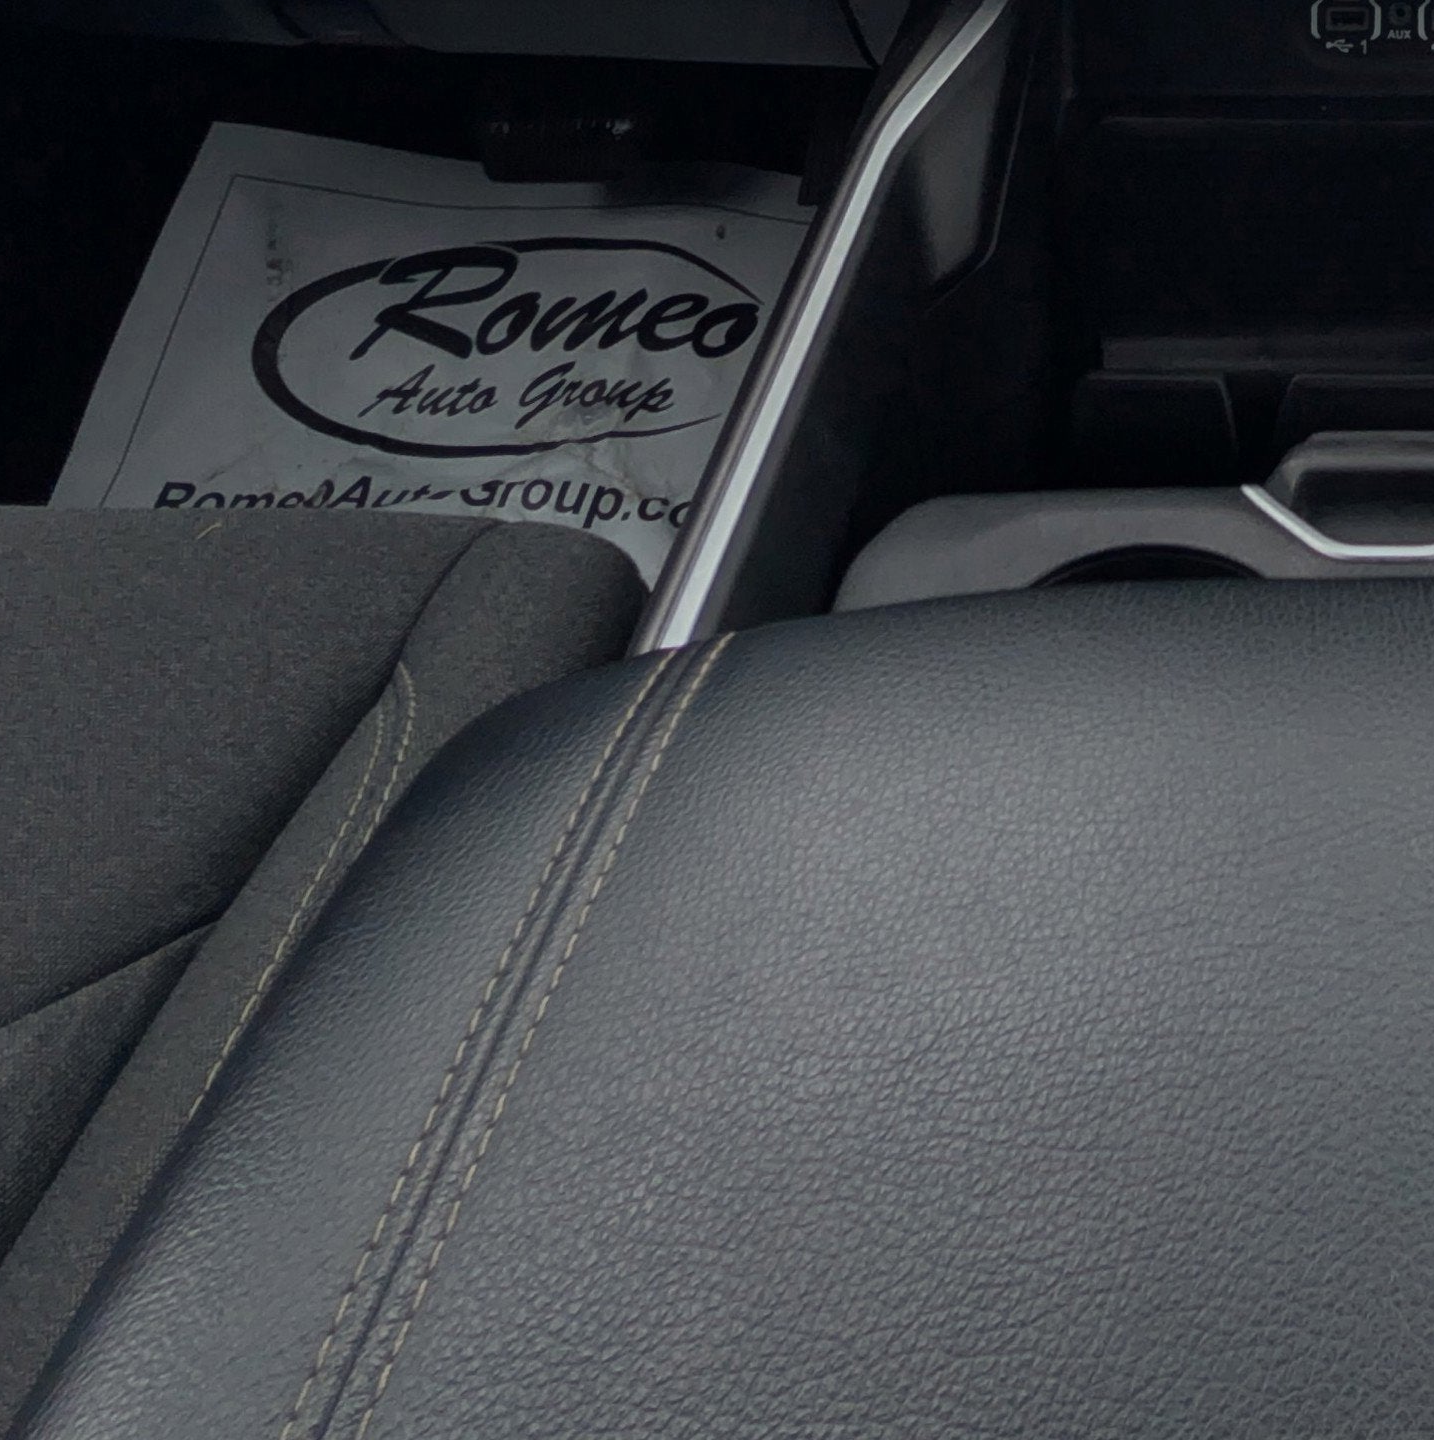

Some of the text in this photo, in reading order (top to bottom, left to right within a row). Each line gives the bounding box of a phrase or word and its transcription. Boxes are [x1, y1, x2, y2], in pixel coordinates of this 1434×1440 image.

[1387, 29, 1412, 40] AUX
[348, 246, 761, 360] Romeo
[358, 362, 674, 430] Auto Group
